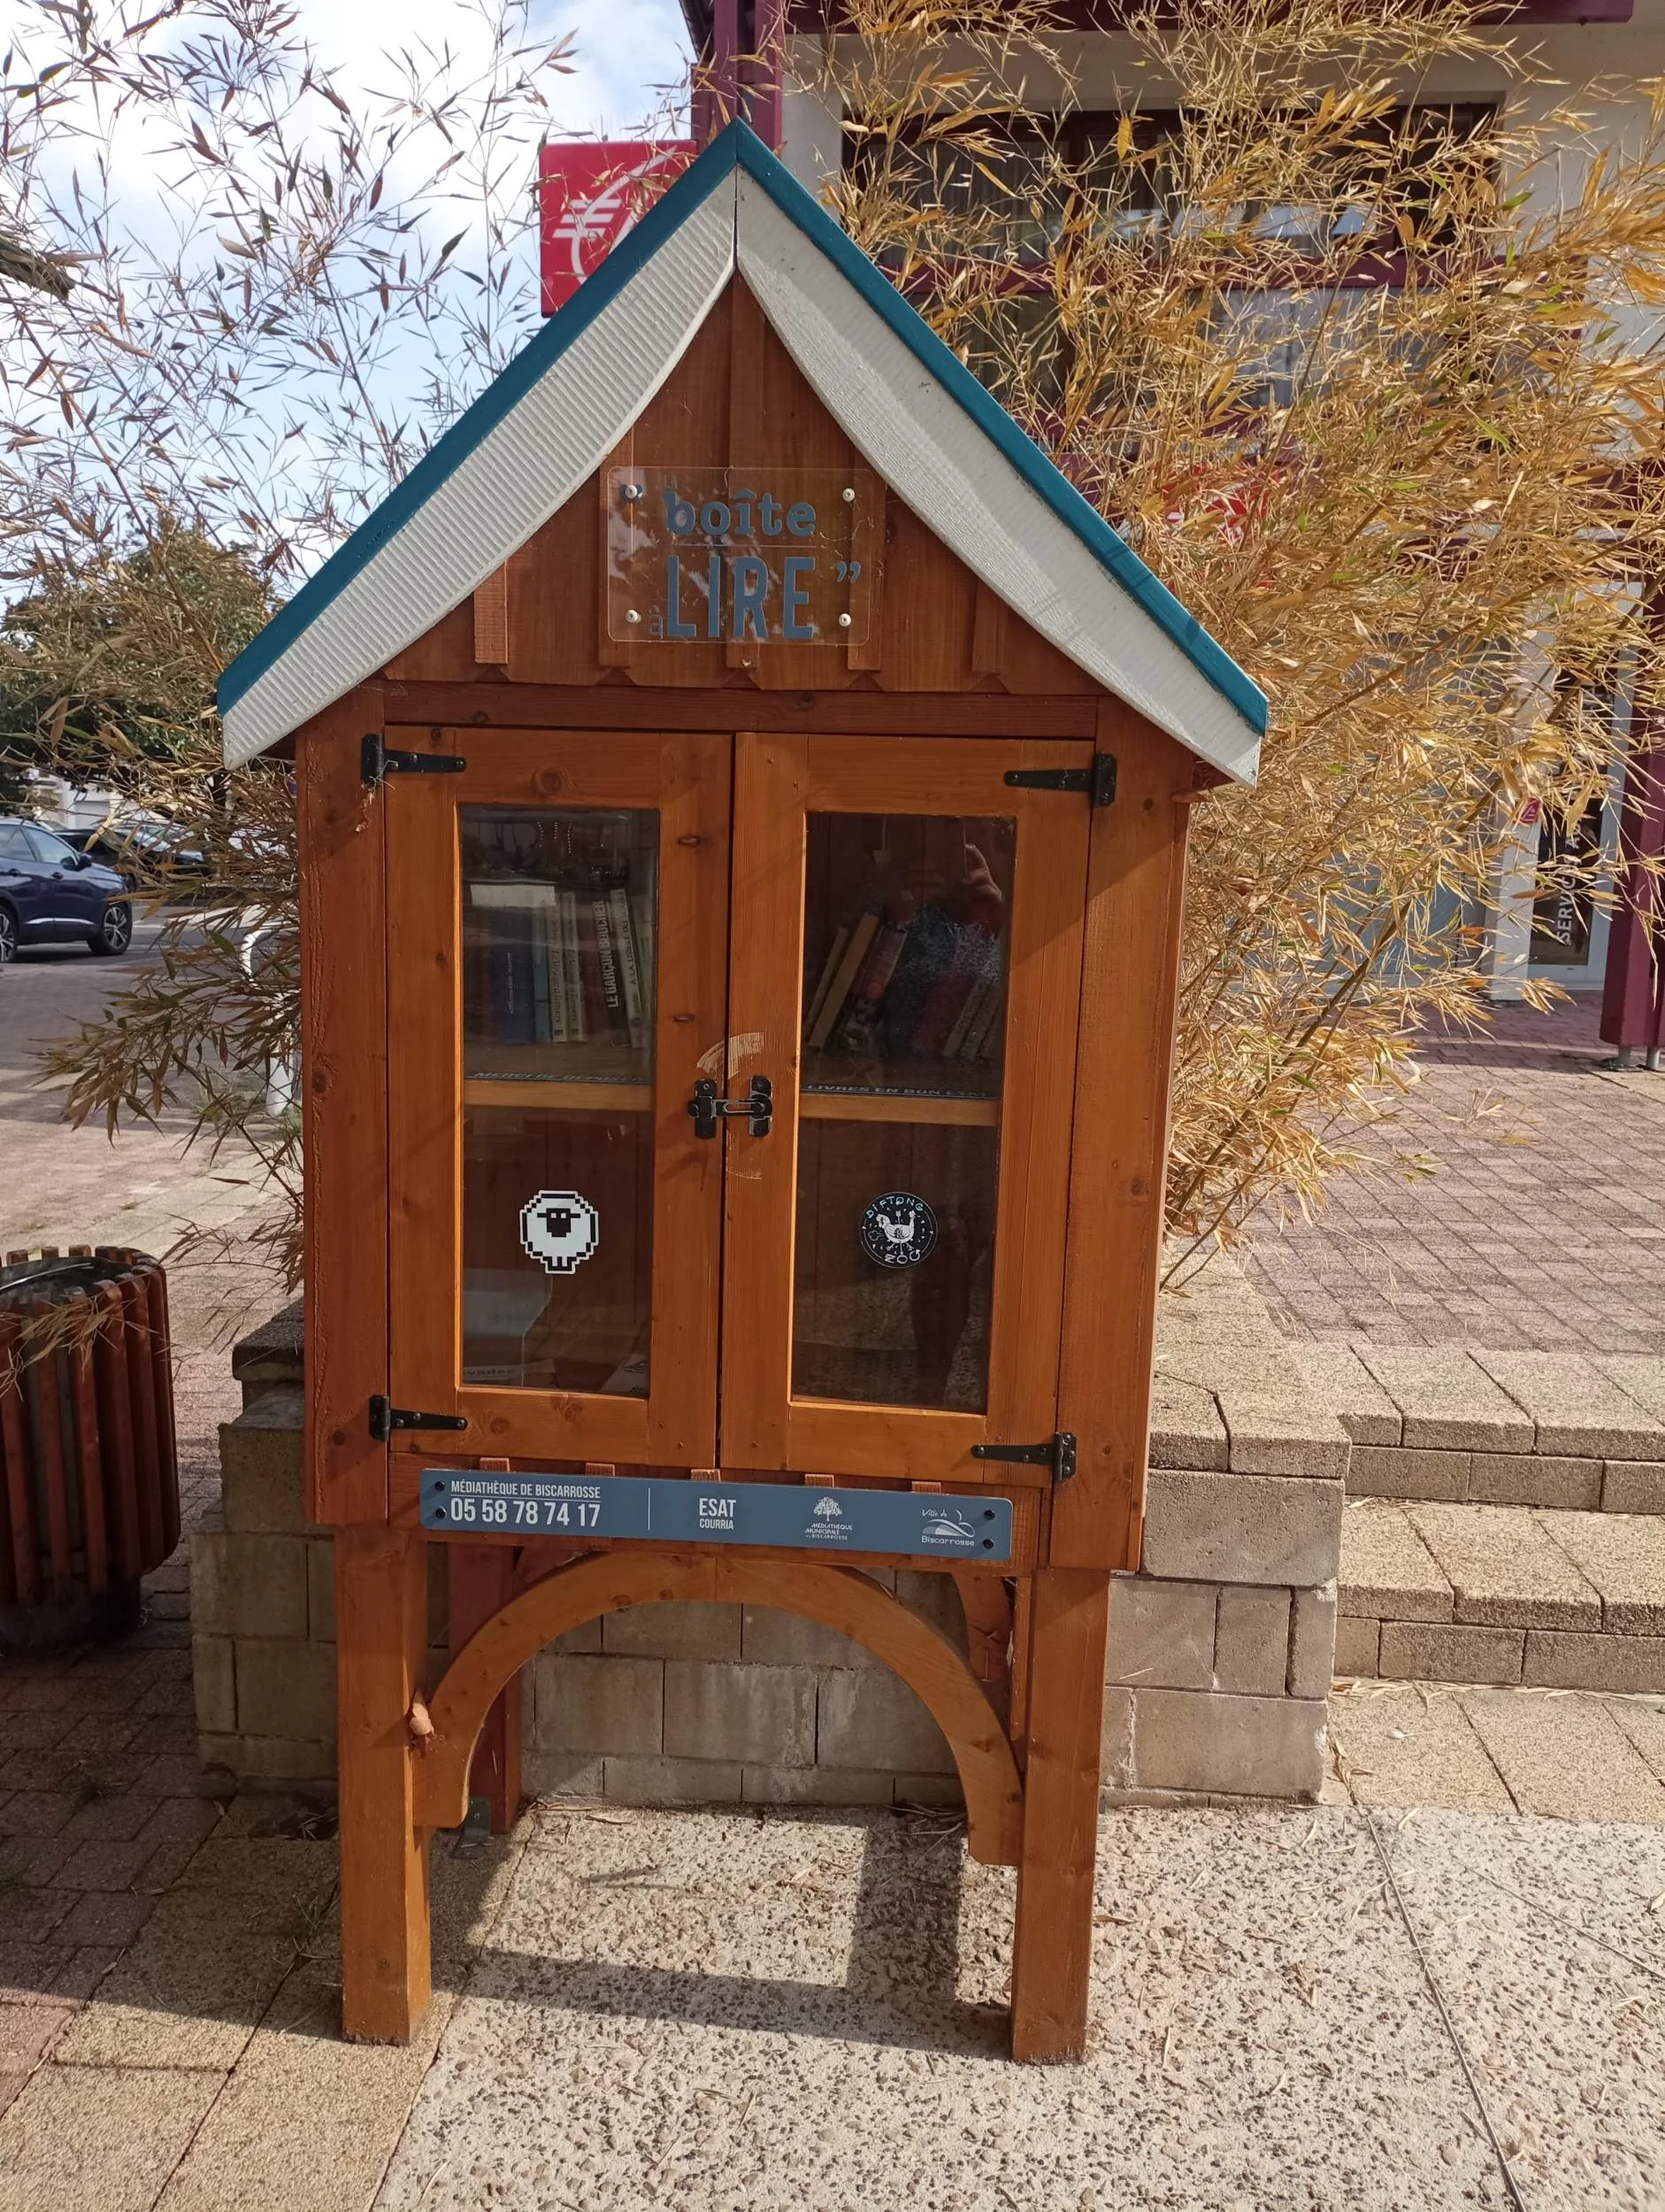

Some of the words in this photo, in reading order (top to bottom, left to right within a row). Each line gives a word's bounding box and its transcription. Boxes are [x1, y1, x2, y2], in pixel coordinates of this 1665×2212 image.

[663, 488, 817, 537] boîte
[667, 555, 817, 639] LIRE
[593, 901, 610, 951] BOUCHER
[599, 951, 618, 994] GARÇON
[608, 994, 619, 1009] LE
[451, 1479, 518, 1495] MÉDIATHÈQUE
[520, 1484, 533, 1495] DE
[535, 1484, 601, 1499] BISCARROSSE
[451, 1497, 476, 1522] 05
[481, 1499, 507, 1524] 58
[513, 1501, 538, 1525] 78
[544, 1502, 570, 1526] 74
[577, 1504, 601, 1528] 17
[698, 1497, 737, 1517] ESAT
[922, 1509, 938, 1517] Ville
[699, 1517, 734, 1531] COURRIA
[921, 1535, 975, 1547] Biscarrosse
